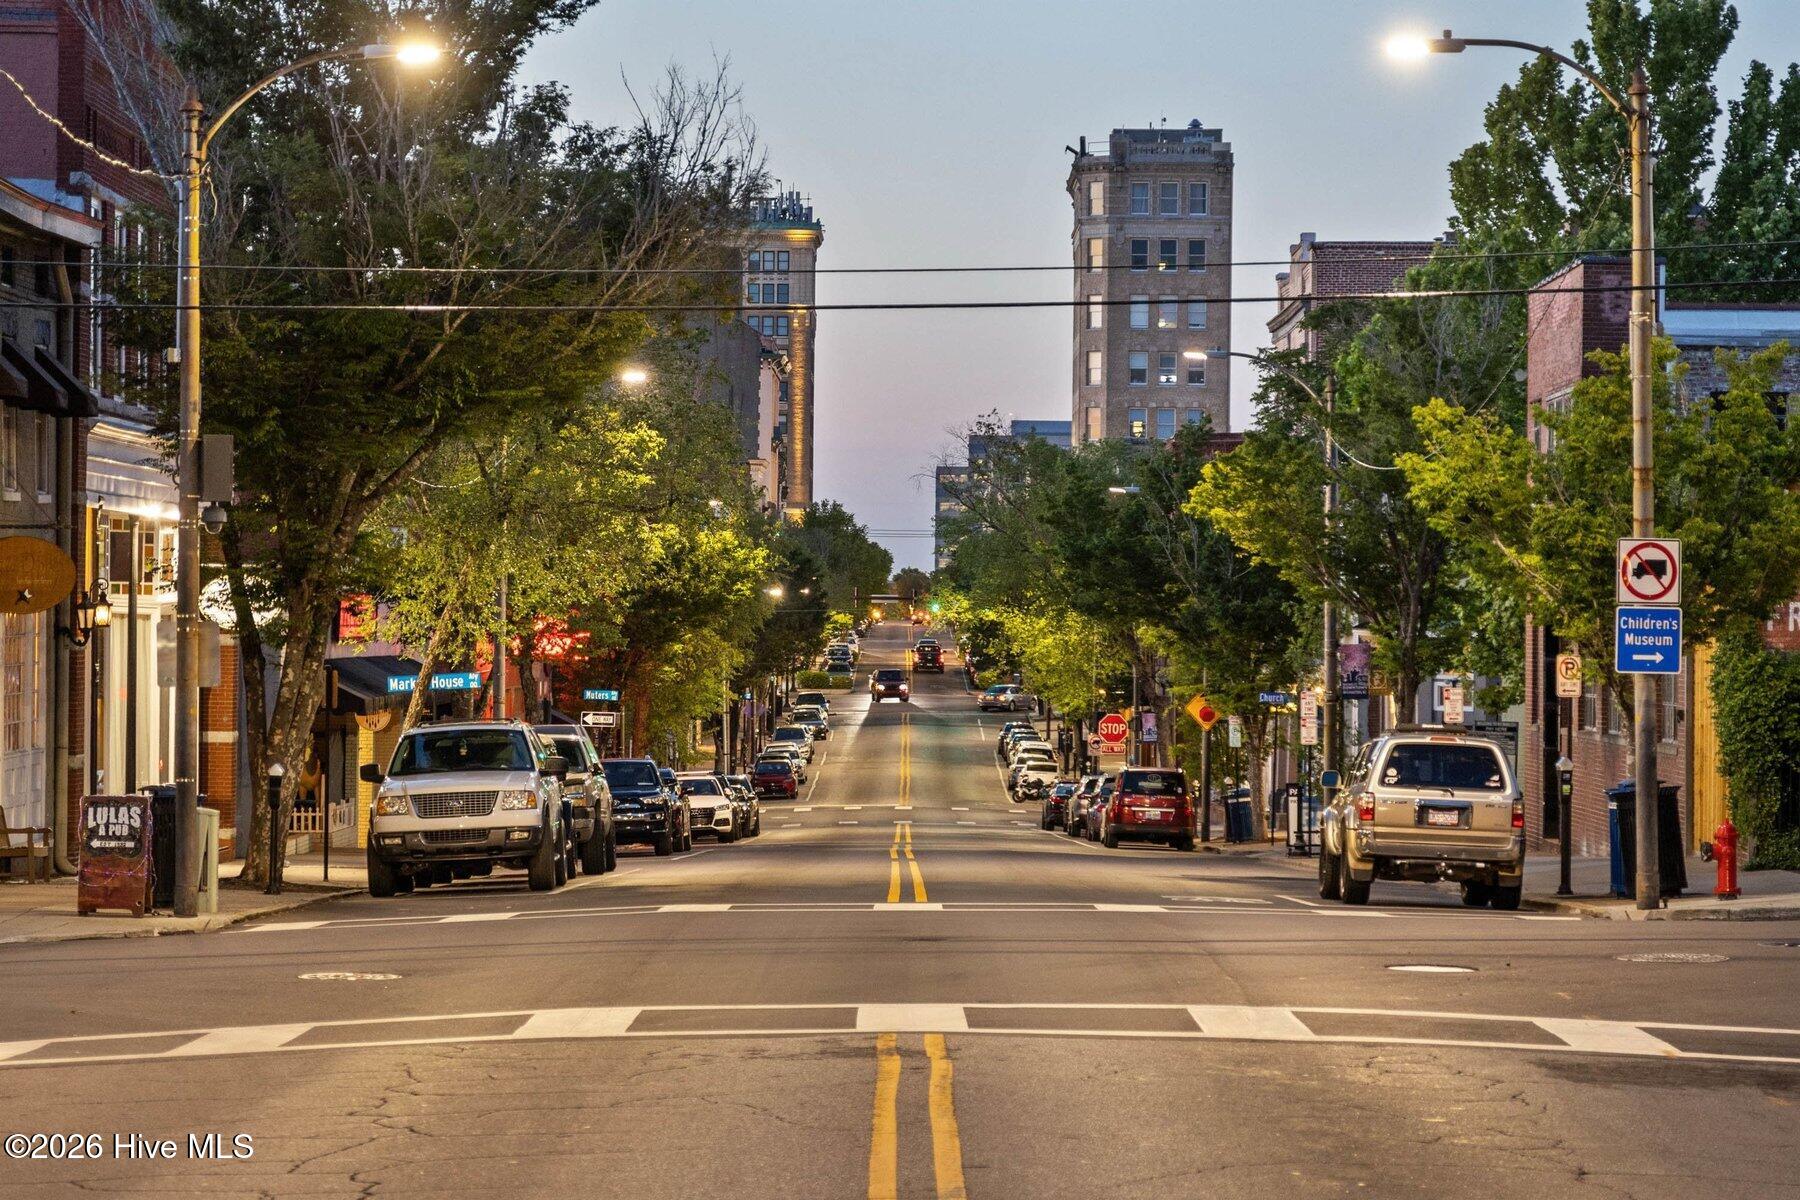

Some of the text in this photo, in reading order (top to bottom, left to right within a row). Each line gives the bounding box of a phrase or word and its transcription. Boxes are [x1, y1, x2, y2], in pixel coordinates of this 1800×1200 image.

[1620, 616, 1678, 630] Children's
[1625, 633, 1673, 646] Museum
[389, 676, 464, 691] Mark House
[1260, 693, 1284, 703] Church
[1101, 723, 1126, 735] STOP
[87, 806, 142, 829] LULAS
[98, 824, 129, 836] A PUB
